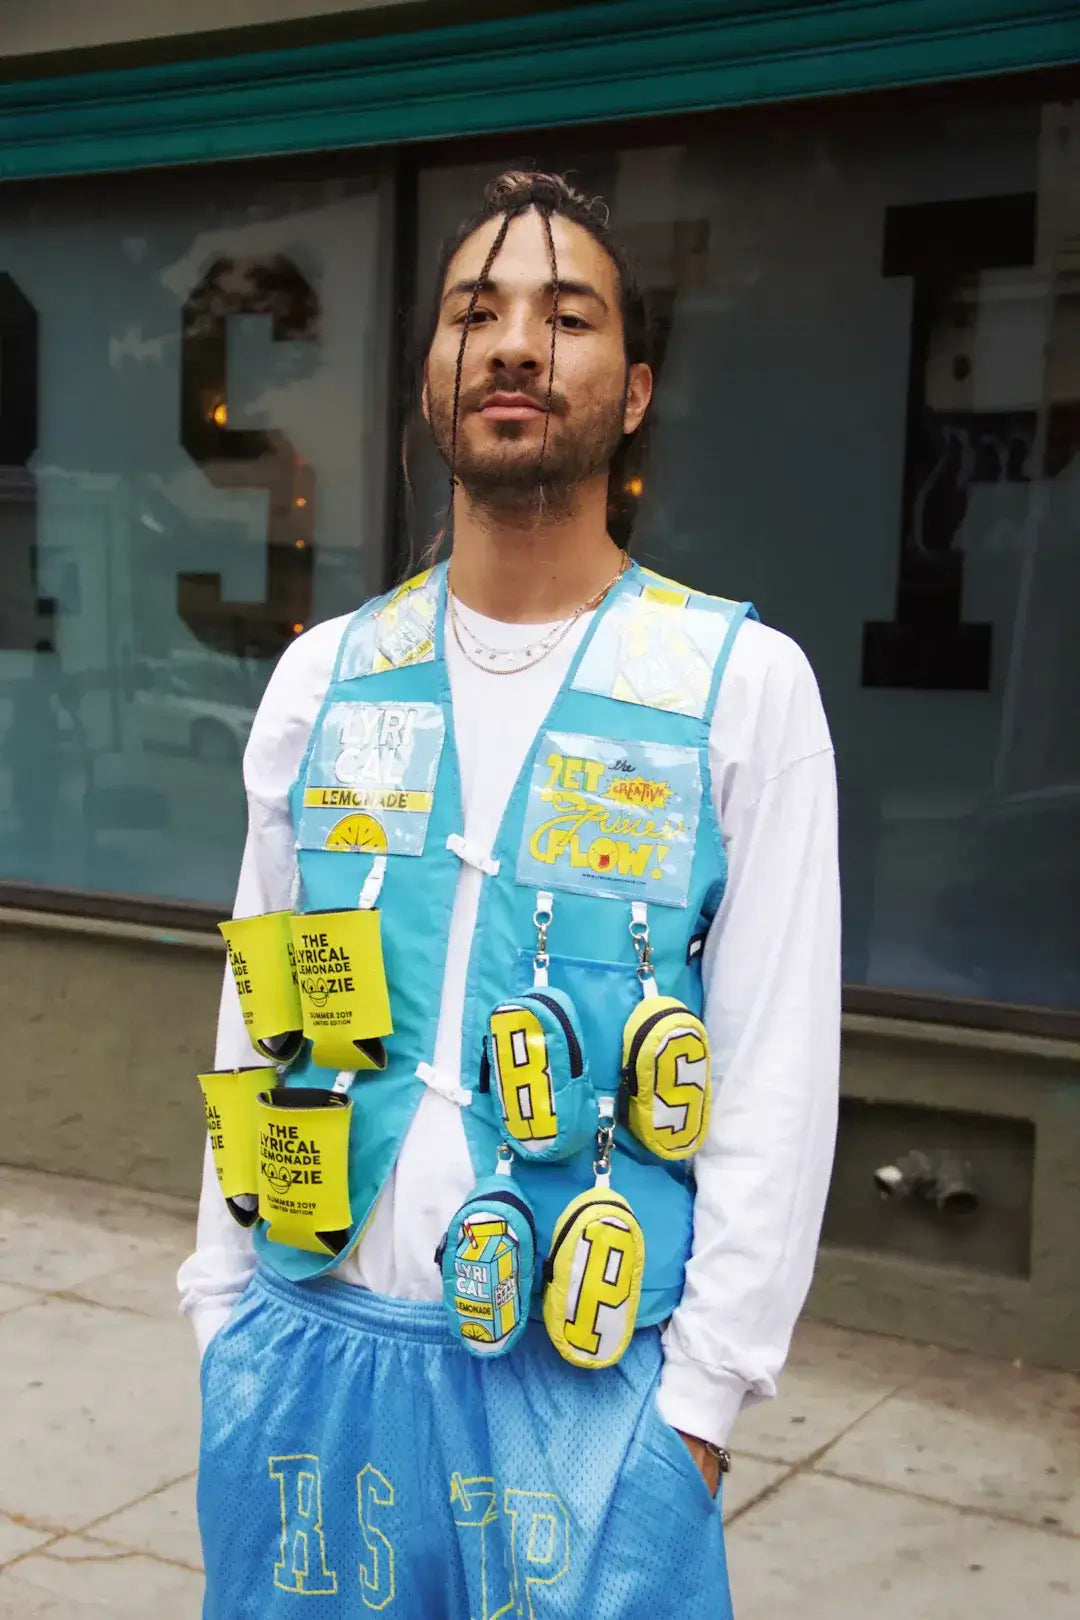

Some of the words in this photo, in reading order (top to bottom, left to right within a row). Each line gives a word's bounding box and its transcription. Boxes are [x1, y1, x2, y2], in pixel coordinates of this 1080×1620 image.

[178, 252, 318, 660] S
[339, 708, 417, 746] LYRI
[334, 746, 403, 784] CAL
[608, 759, 636, 773] the
[545, 829, 670, 880] FLOW!
[302, 933, 329, 948] THE
[296, 946, 350, 964] LYRICAL
[299, 961, 352, 975] LEMONADE
[309, 1012, 334, 1020] SUMMER
[336, 1011, 353, 1019] 2019
[654, 1032, 708, 1151] S
[268, 1122, 299, 1140] THE
[260, 1130, 320, 1155] LYRICAL
[260, 1148, 321, 1165] LEMONADE
[267, 1194, 295, 1209] SUMMER
[297, 1201, 316, 1209] 2019
[270, 1203, 289, 1214] LIMITED
[290, 1207, 313, 1216] EDITION
[454, 1261, 487, 1283] LYRI
[456, 1276, 490, 1299] CAL
[564, 1219, 636, 1355] P
[456, 1300, 492, 1316] LEMONADE
